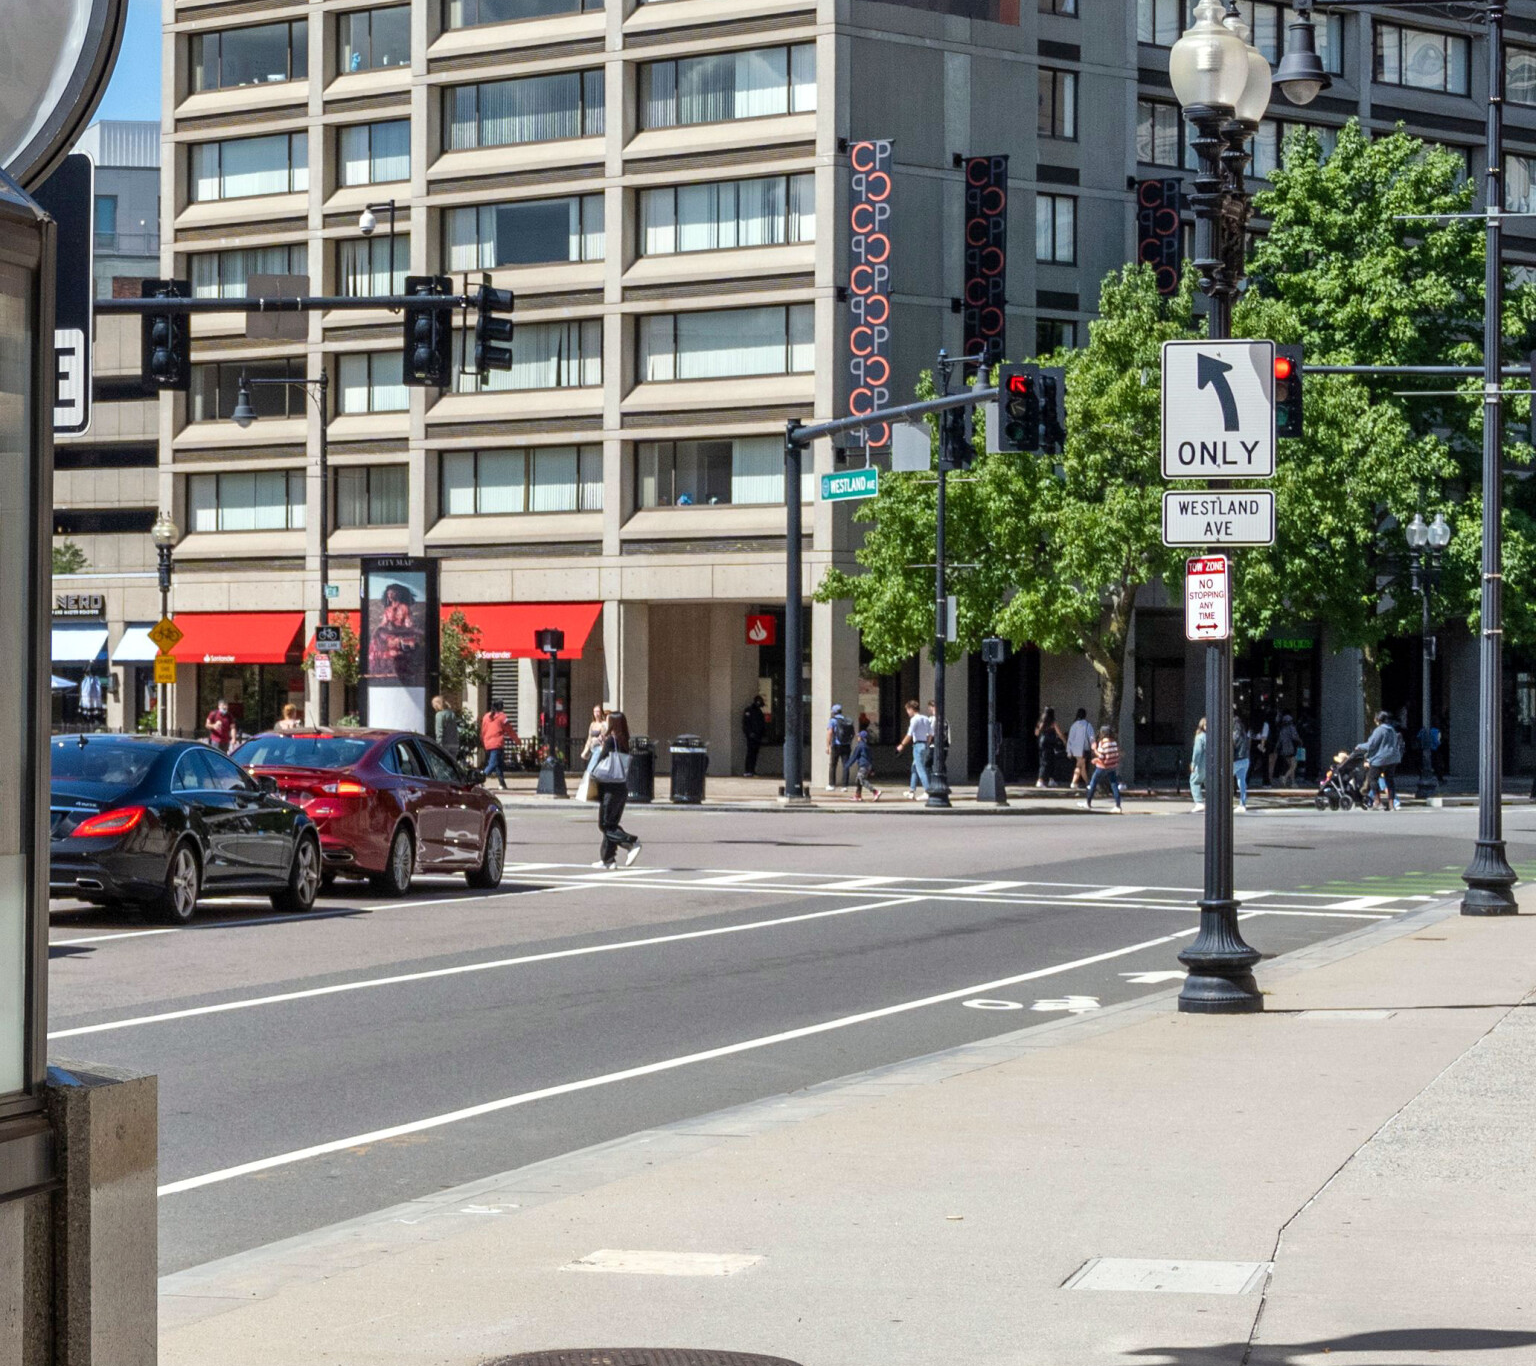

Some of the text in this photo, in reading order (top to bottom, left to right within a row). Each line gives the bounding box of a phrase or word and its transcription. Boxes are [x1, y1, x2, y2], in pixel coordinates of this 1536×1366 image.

[1178, 441, 1260, 466] ONLY
[830, 476, 866, 494] WESTLAND
[1178, 500, 1259, 515] WESTLAND
[1204, 521, 1233, 536] AVE
[378, 559, 413, 567] CITY MAP
[1189, 561, 1224, 573] TOW ZONE
[1199, 579, 1213, 589] NO
[1189, 591, 1224, 600] STOPPING
[1199, 601, 1214, 610] ANY
[1198, 611, 1215, 620] TIME
[482, 651, 512, 659] Santander
